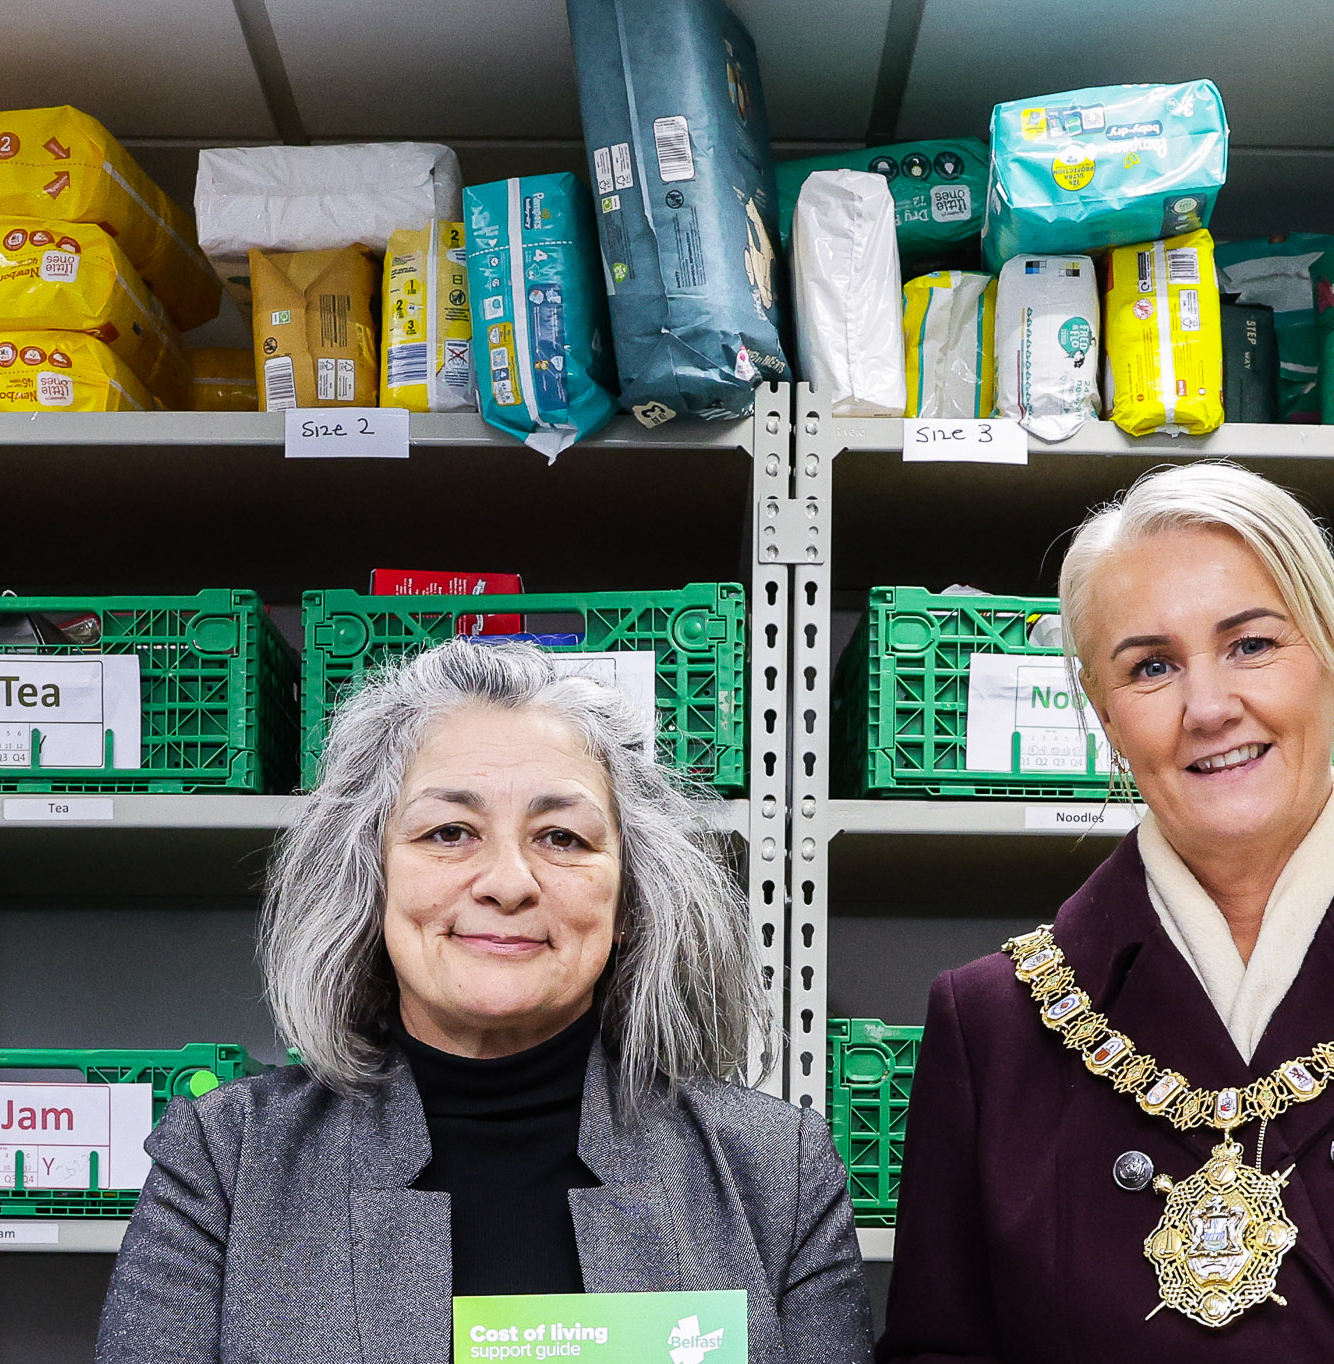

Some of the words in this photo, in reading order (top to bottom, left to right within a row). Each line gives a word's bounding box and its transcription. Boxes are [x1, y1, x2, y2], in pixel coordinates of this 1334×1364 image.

[357, 418, 375, 438] 2
[978, 423, 994, 443] 3
[48, 803, 69, 813] Tea
[1056, 813, 1104, 822] Noodles
[1, 1100, 74, 1131] Jam
[470, 1326, 518, 1343] Cost
[524, 1324, 546, 1341] of
[551, 1322, 609, 1344] living
[670, 1335, 722, 1349] Belfast
[470, 1344, 532, 1361] support
[536, 1342, 581, 1359] guide
